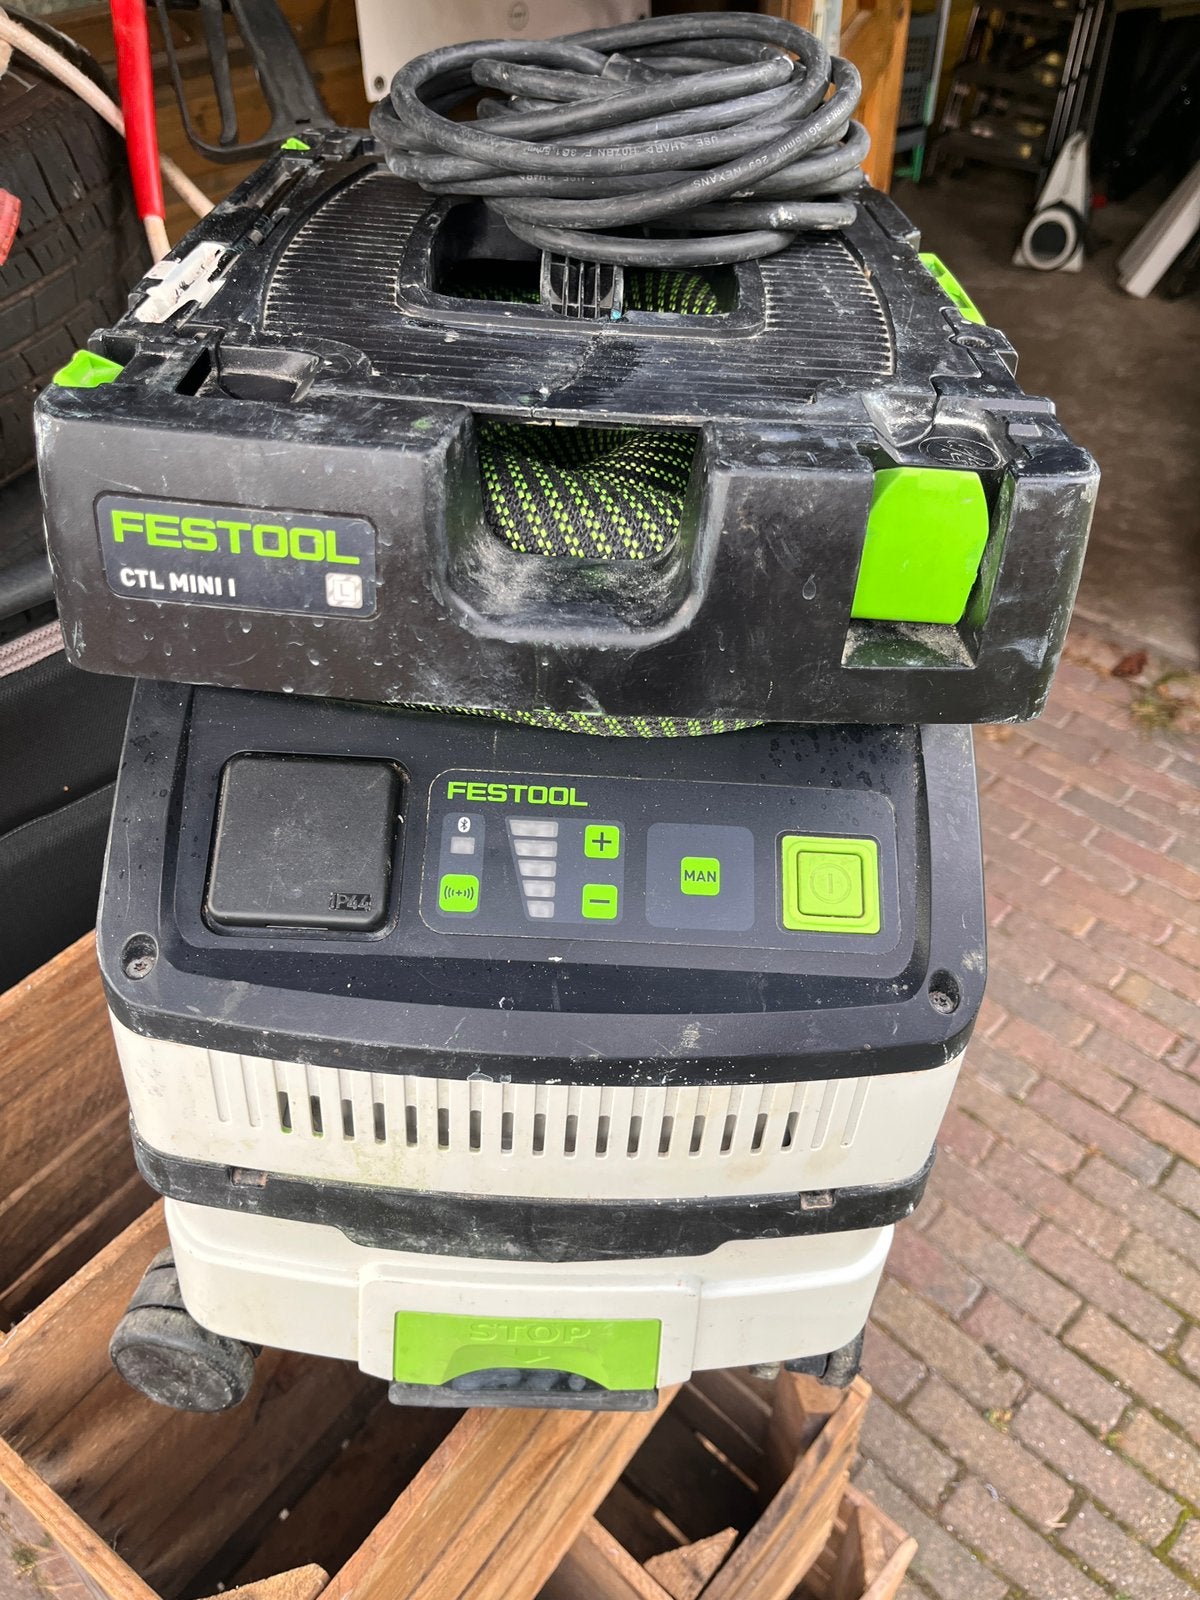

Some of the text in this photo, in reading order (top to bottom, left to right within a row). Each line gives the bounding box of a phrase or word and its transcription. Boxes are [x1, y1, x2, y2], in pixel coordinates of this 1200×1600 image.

[111, 510, 360, 565] FESTOOL
[120, 568, 164, 590] CTL
[169, 572, 222, 596] MINI
[447, 781, 588, 807] FESTOOL
[684, 869, 717, 883] MAN
[329, 892, 371, 912] IP44
[470, 1323, 592, 1344] STOP
